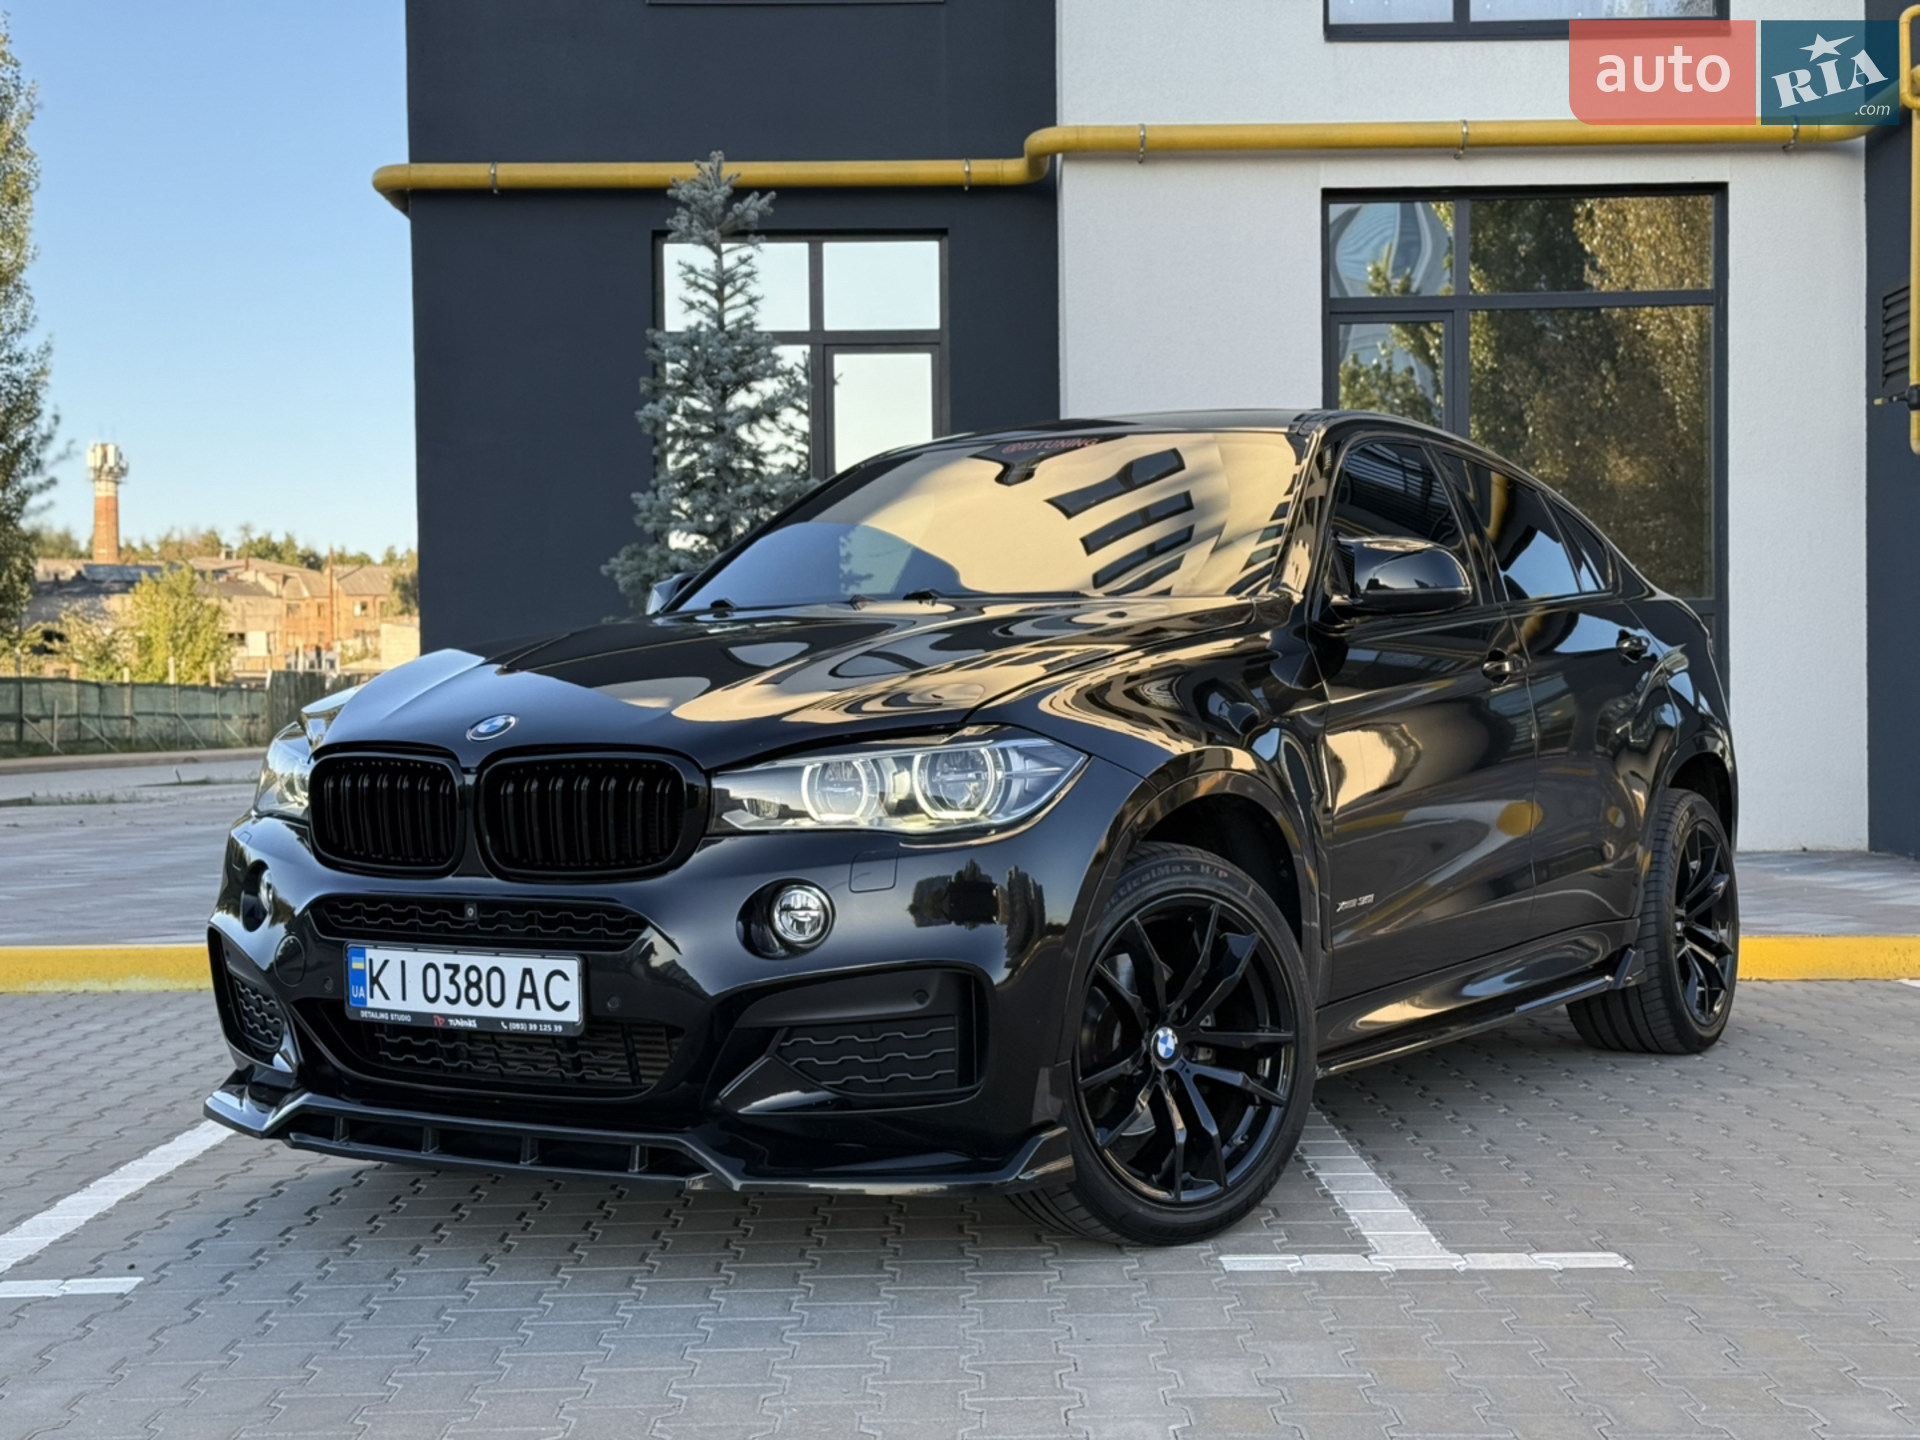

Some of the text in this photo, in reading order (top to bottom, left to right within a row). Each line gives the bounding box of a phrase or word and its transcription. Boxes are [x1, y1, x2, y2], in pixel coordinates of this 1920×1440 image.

[1200, 864, 1229, 878] H/P
[351, 985, 366, 998] UA
[369, 958, 571, 1012] KI 0380 AC
[360, 1010, 411, 1022] DETAILING STUDIO
